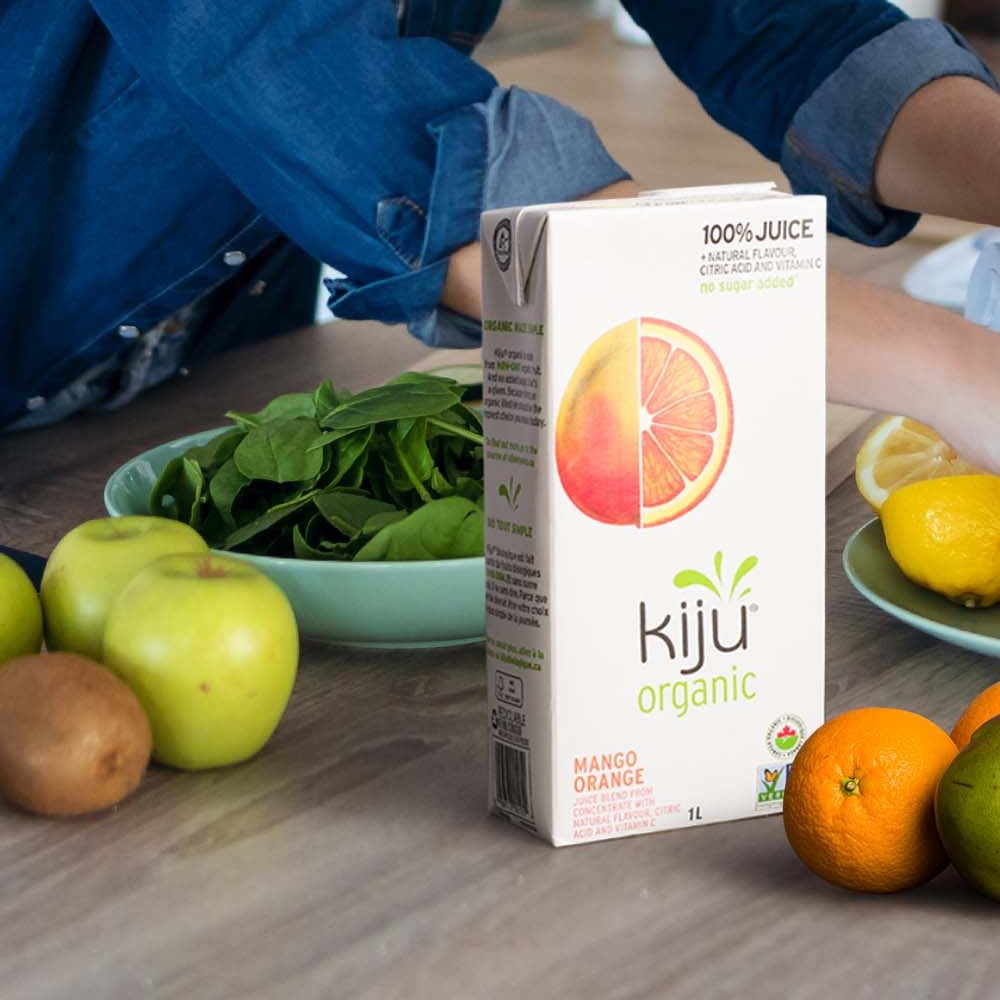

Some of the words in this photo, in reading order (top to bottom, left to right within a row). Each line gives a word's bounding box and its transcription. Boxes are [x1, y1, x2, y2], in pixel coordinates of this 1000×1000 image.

[702, 221, 753, 245] 100%
[755, 218, 814, 241] JUICE
[708, 249, 750, 262] NATURAL
[700, 263, 729, 276] CITRIC
[731, 262, 752, 274] ACID
[754, 261, 774, 272] AND
[700, 282, 715, 293] no
[720, 280, 752, 293] sugar
[639, 599, 748, 675] kiju
[638, 665, 757, 718] organic
[573, 750, 638, 775] MANGO
[573, 767, 645, 793] ORANGE
